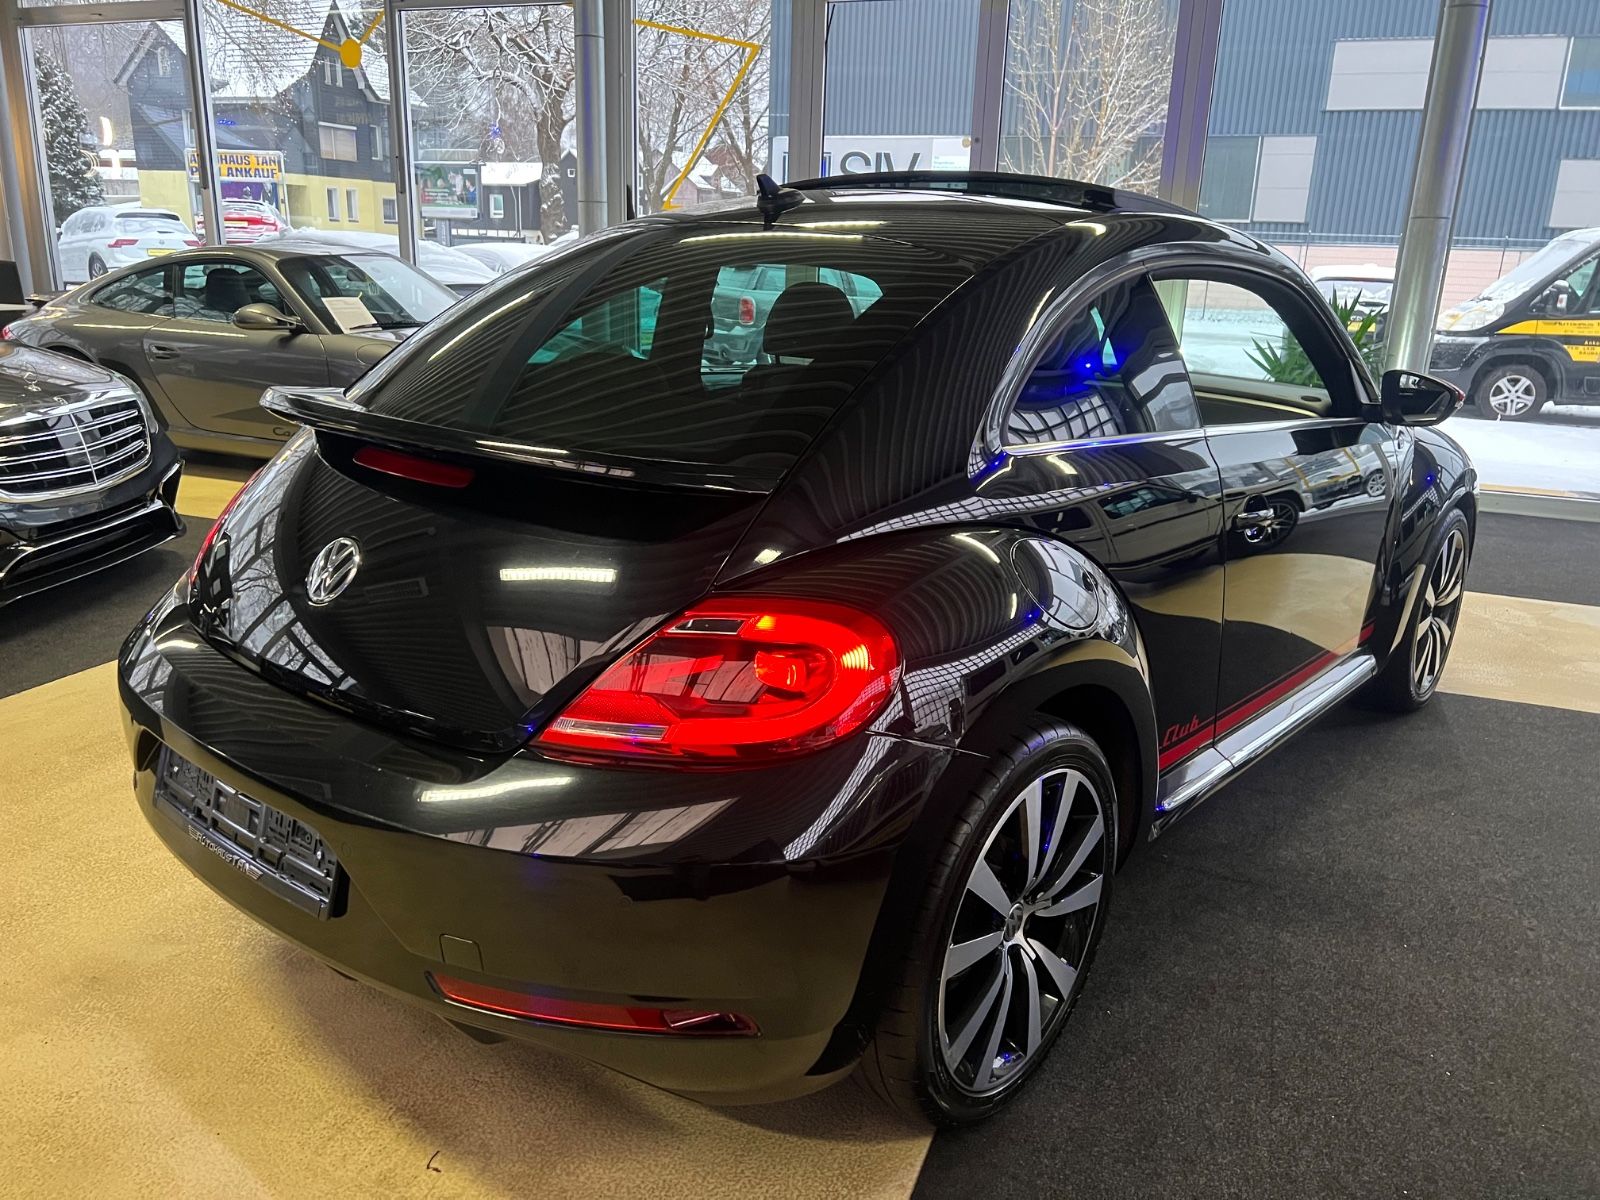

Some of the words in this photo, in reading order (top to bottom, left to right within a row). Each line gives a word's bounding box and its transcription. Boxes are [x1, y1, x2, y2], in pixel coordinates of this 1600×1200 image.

[189, 153, 251, 165] AHAUS
[255, 154, 277, 167] TAN
[226, 167, 278, 179] ANKAUF
[1162, 714, 1199, 747] Club
